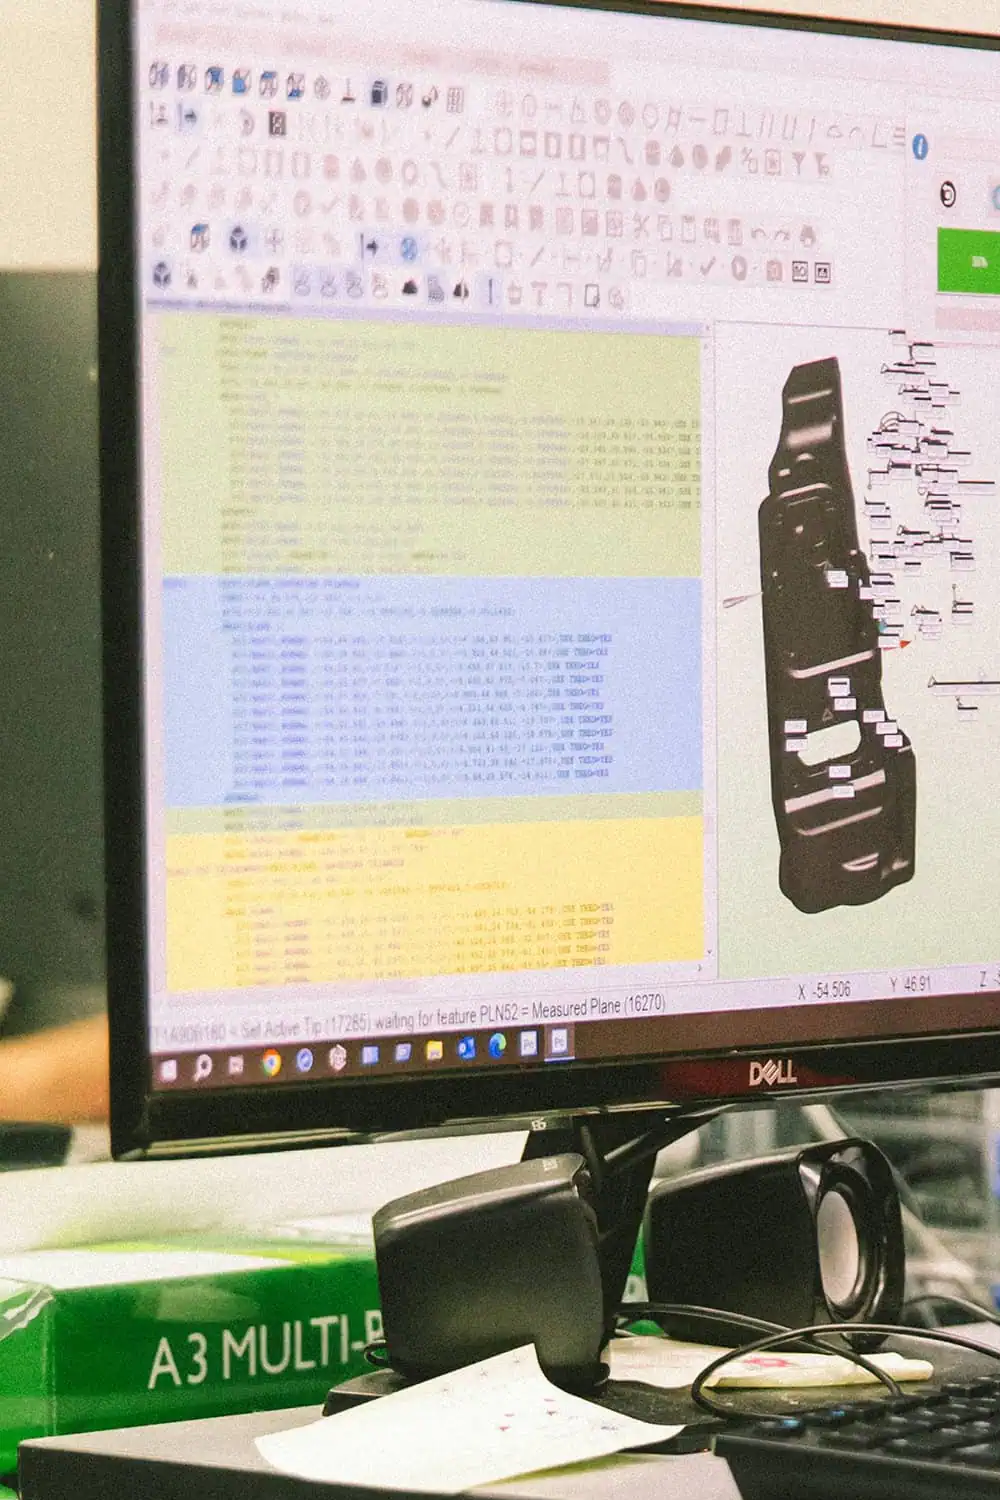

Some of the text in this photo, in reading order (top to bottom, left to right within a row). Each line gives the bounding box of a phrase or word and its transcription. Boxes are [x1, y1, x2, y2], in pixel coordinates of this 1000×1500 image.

[890, 976, 898, 992] Y
[979, 970, 987, 988] Z
[798, 983, 806, 1001] X
[304, 1016, 322, 1038] Tip
[375, 1010, 414, 1032] waiting
[418, 1009, 434, 1027] for
[437, 1008, 476, 1026] feature
[480, 1002, 519, 1023] PLN52
[532, 1000, 588, 1019] Measured
[591, 997, 621, 1015] Plane
[624, 993, 666, 1015] (16270)
[749, 1059, 798, 1086] DELL
[148, 1332, 207, 1390] A3
